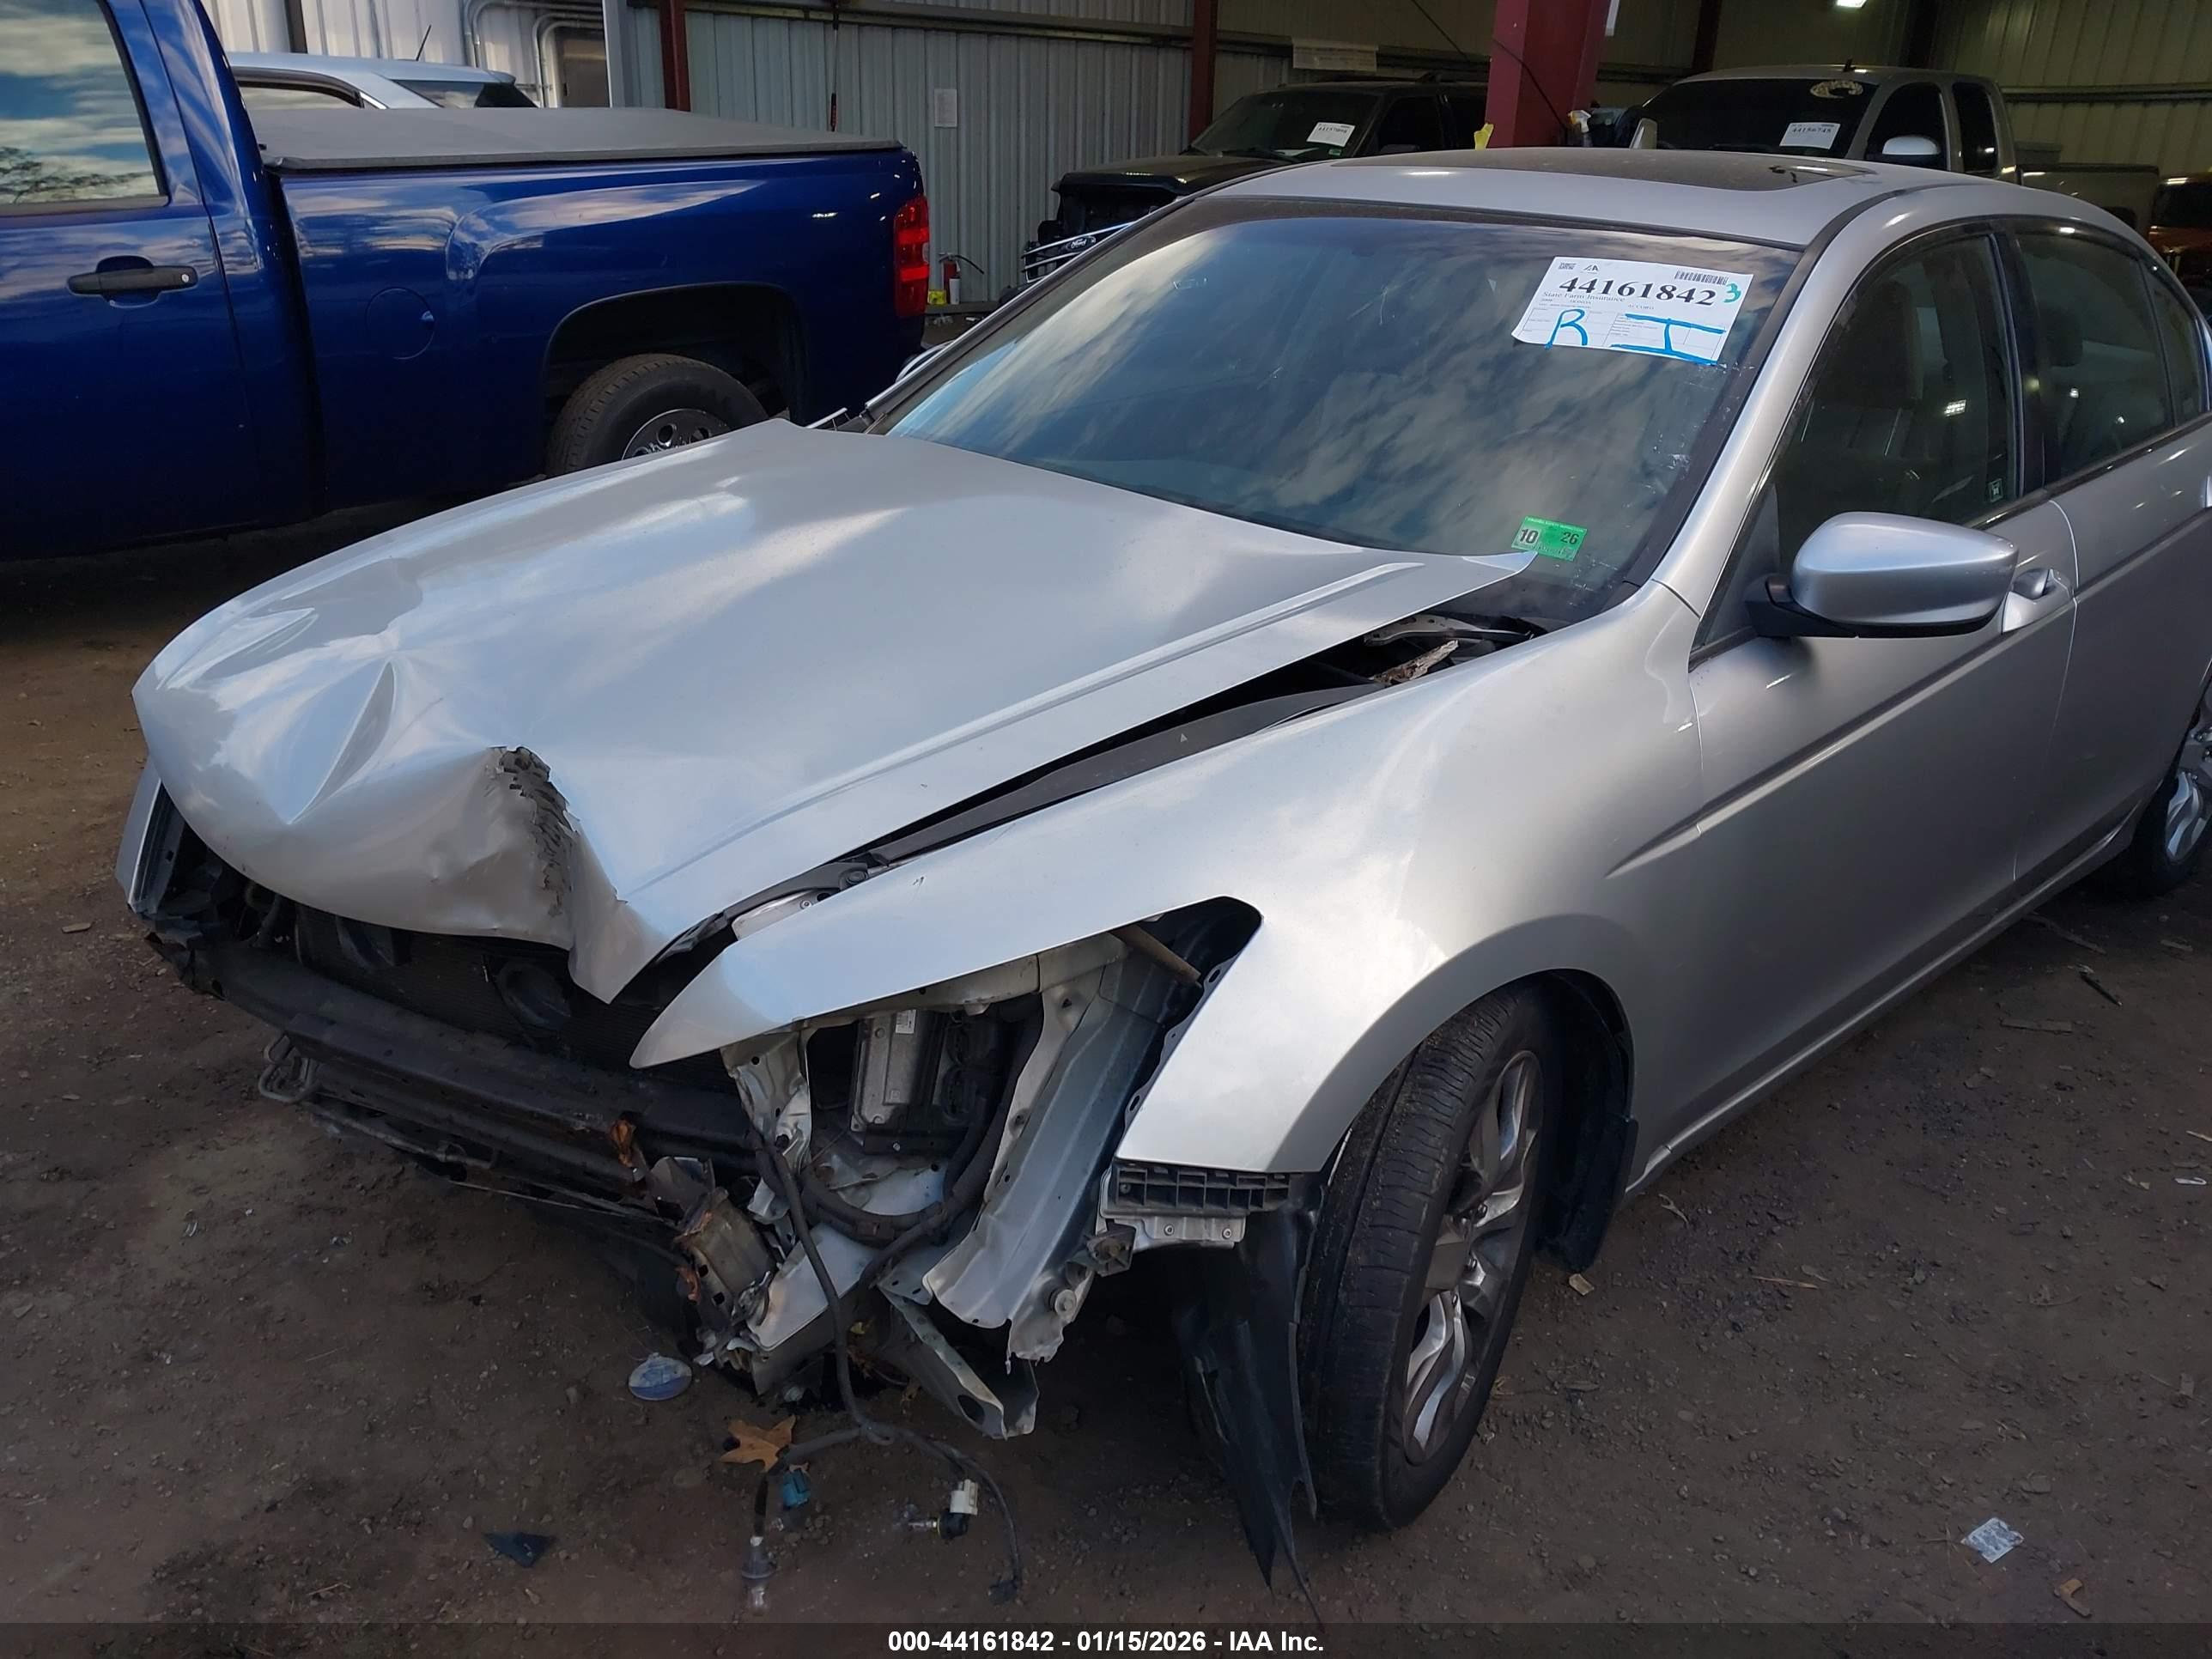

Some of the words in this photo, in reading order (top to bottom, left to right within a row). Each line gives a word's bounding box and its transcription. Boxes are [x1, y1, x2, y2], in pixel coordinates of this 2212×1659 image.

[1559, 276, 1717, 307] 44161842
[1723, 283, 1742, 303] 3
[1545, 308, 1589, 349] R
[1519, 528, 1540, 544] 10
[1559, 532, 1580, 545] 26
